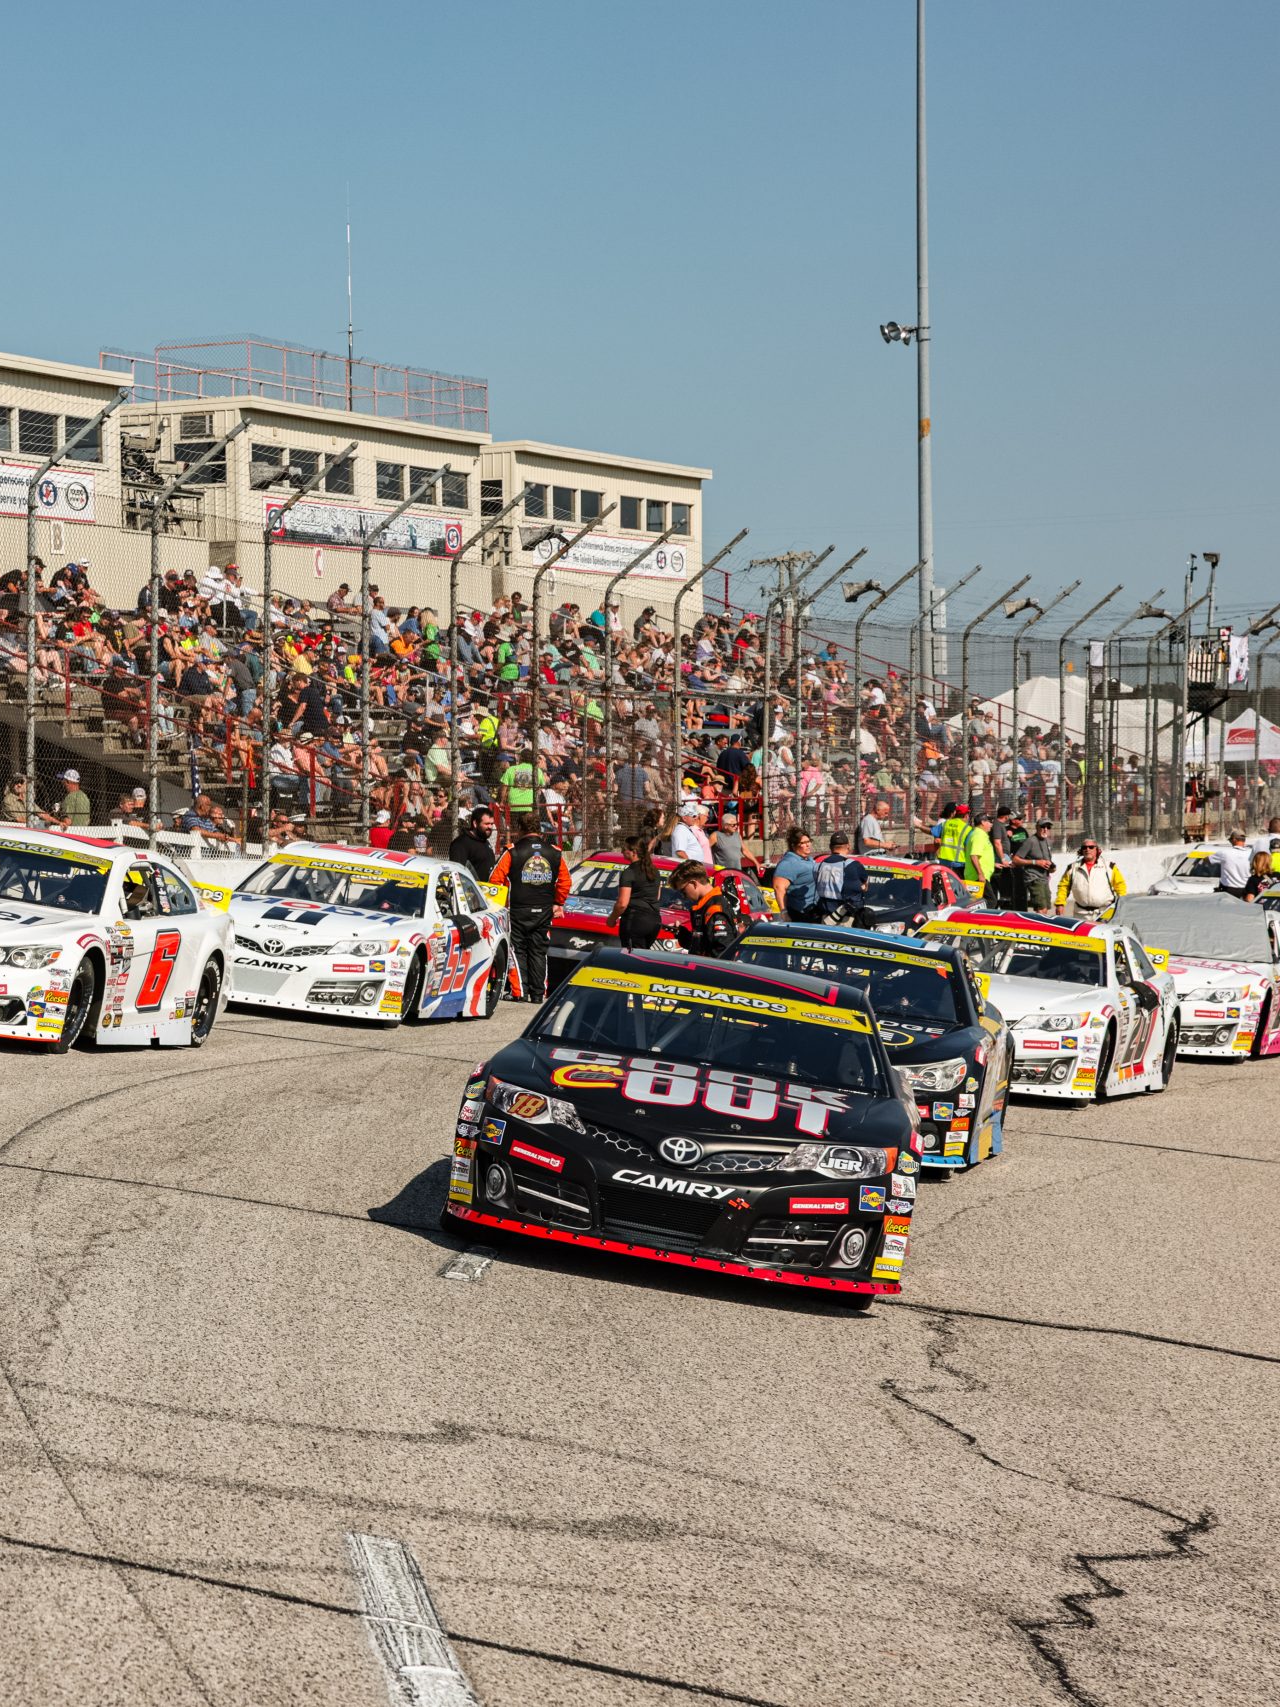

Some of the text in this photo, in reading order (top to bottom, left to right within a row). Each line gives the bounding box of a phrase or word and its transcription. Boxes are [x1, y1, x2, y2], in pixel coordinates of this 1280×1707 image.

[0, 496, 17, 505] serve
[310, 861, 383, 875] MENARDS
[232, 894, 403, 925] Mobil
[968, 928, 1052, 943] MENARDS
[793, 939, 897, 959] MENARDS
[234, 957, 308, 972] CAMRY
[438, 927, 472, 995] 55
[135, 928, 181, 1014] 6
[592, 978, 641, 988] MENARDS
[650, 983, 788, 1013] MENARDS
[801, 1011, 853, 1025] MENARDS
[879, 1019, 946, 1035] DGE
[551, 1048, 852, 1109] COOK
[508, 1093, 546, 1118] 18
[622, 1068, 846, 1138] OUT
[483, 1127, 503, 1136] SUNOCO
[513, 1145, 551, 1162] GENERAL TIRE
[821, 1157, 863, 1172] JGR
[898, 1159, 919, 1173] Bounty
[612, 1169, 736, 1199] CAMRY
[861, 1196, 885, 1204] SUNOCO
[876, 1263, 901, 1272] MENARDS
